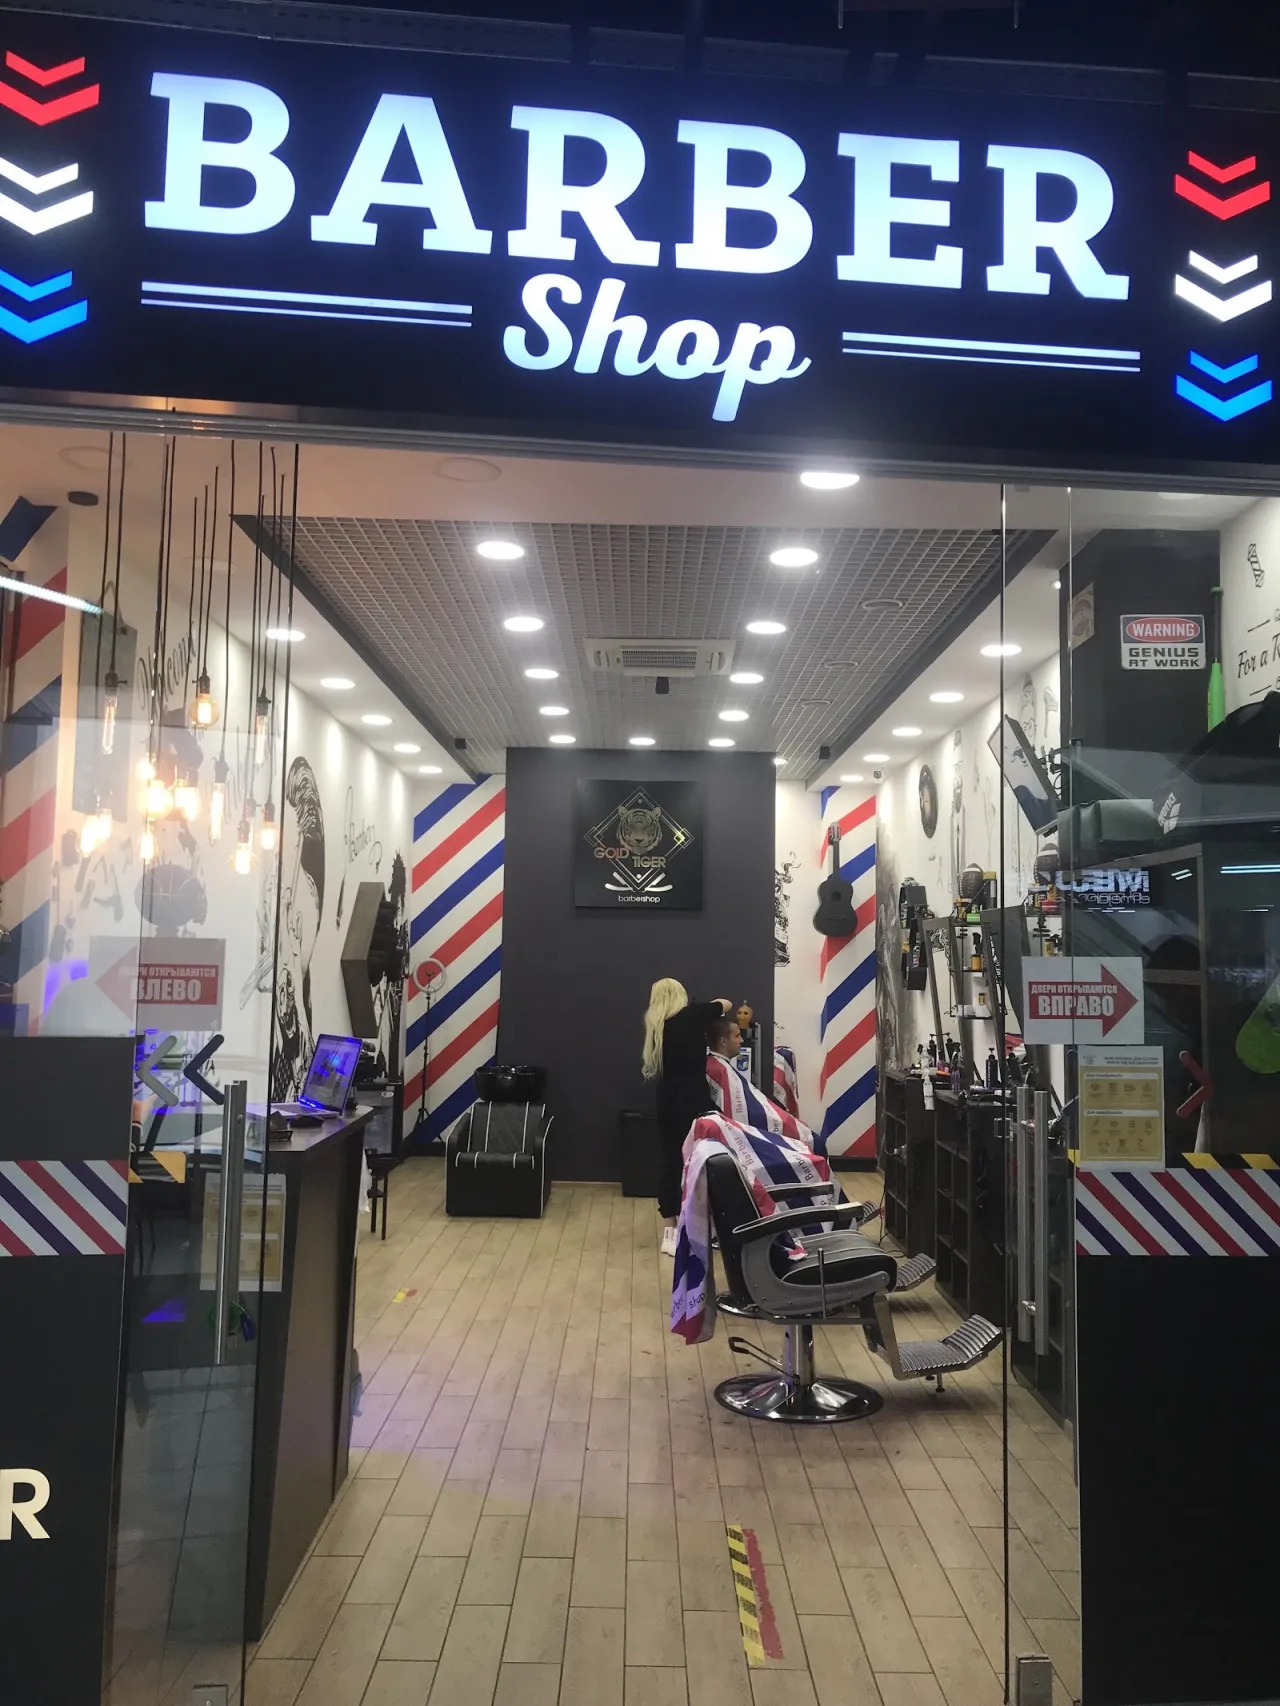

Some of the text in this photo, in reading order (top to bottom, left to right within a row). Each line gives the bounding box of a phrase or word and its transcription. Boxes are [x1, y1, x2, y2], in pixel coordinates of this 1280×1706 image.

[144, 72, 1130, 302] BARBER
[503, 273, 812, 421] Shop
[1132, 623, 1195, 637] WARNING
[1128, 647, 1199, 658] GENIUS
[1129, 659, 1199, 667] AT WORK
[1237, 649, 1257, 679] For
[1260, 650, 1268, 668] a
[594, 847, 629, 859] GOLD
[632, 856, 666, 868] TIGER
[618, 895, 660, 903] barbershop
[130, 979, 202, 1002] ВЛЕВО
[1031, 984, 1118, 995] ДВЕРИ ОТКРЫВАЮТСЯ
[1038, 995, 1115, 1017] ВПРАВО
[734, 1136, 754, 1166] Barber
[792, 1153, 814, 1182] Barber
